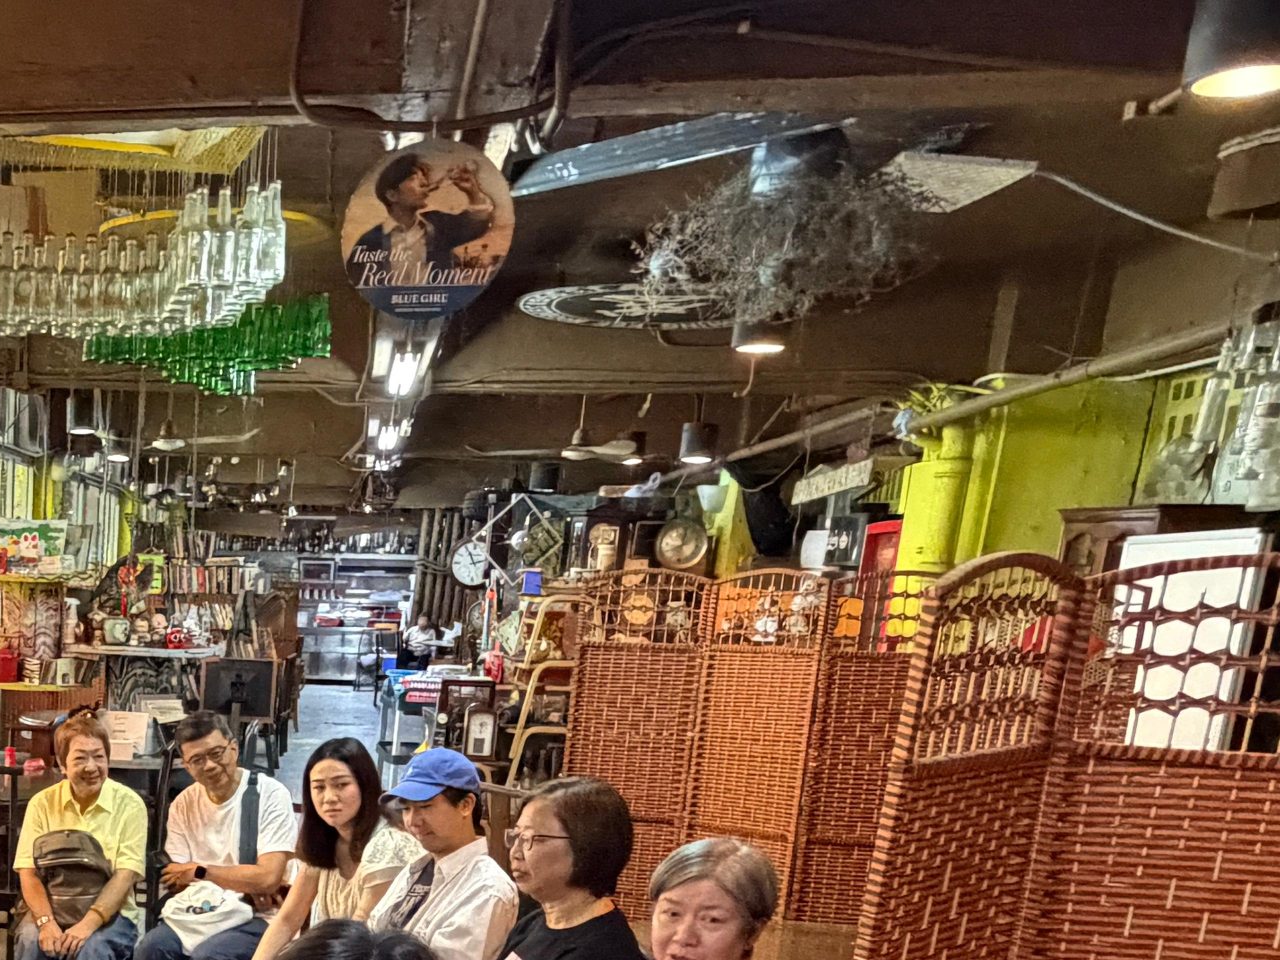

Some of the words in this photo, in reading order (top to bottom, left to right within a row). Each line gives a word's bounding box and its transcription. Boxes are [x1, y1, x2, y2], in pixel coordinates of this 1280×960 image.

[353, 245, 388, 263] Taste
[389, 245, 412, 261] the
[359, 262, 408, 287] Real
[410, 260, 496, 287] Moment
[391, 294, 419, 304] BLUE
[420, 293, 449, 304] GIRL
